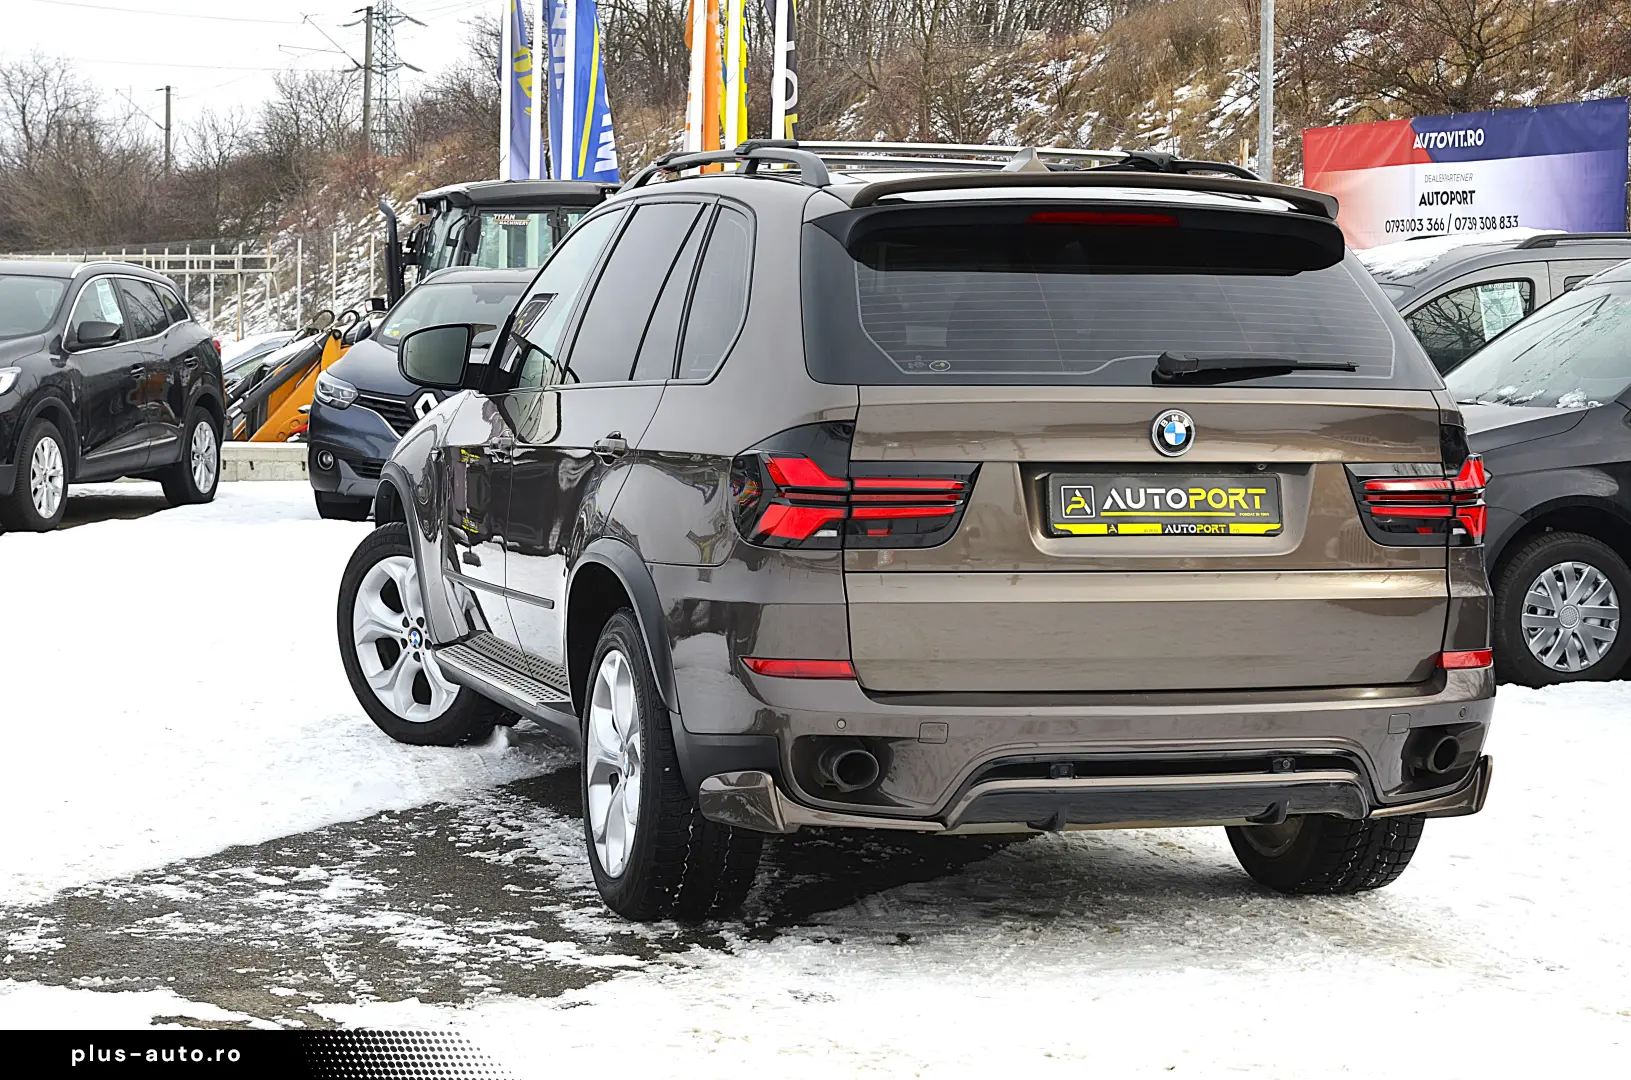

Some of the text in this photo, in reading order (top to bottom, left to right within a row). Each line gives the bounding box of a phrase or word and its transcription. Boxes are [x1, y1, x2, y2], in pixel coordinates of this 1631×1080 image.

[1418, 190, 1476, 207] AUTOPORT
[1426, 217, 1445, 231] 366
[1454, 215, 1478, 231] 0739
[1479, 215, 1497, 231] 308
[1499, 214, 1519, 229] 833
[1102, 487, 1267, 510] AUTOPORT
[1164, 523, 1227, 534] AUTOPORT
